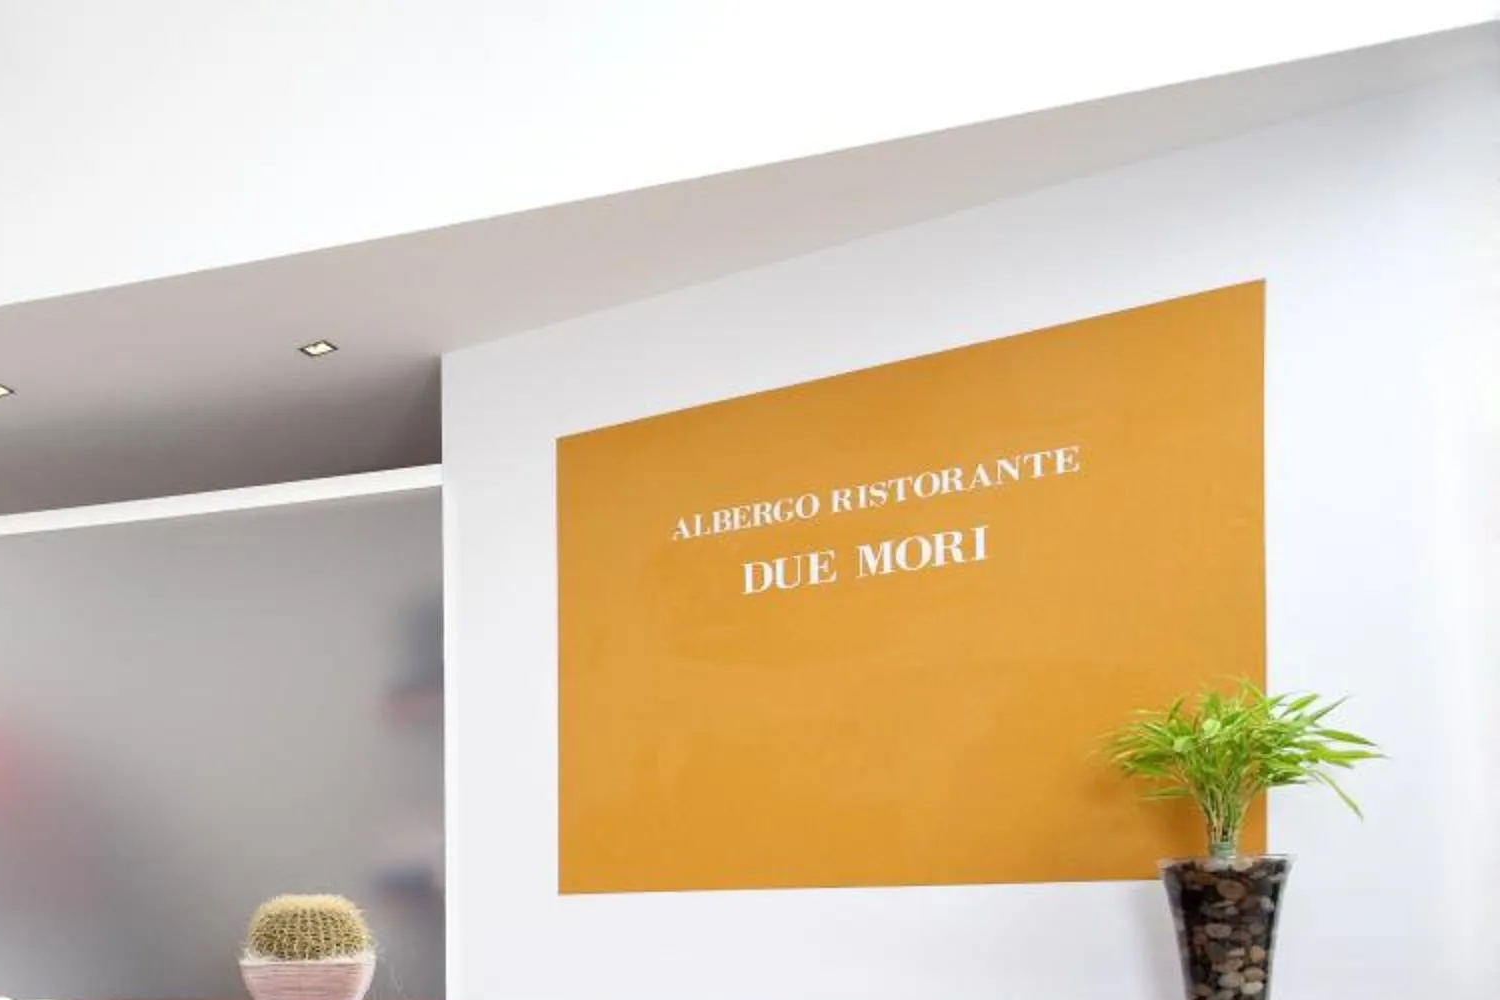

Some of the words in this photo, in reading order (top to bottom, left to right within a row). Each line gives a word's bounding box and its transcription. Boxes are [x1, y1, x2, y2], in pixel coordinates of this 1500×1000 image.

[672, 492, 820, 541] ALBERGO
[830, 446, 1080, 512] RISTORANTE
[741, 551, 838, 595] DUE
[855, 525, 989, 578] MORI
